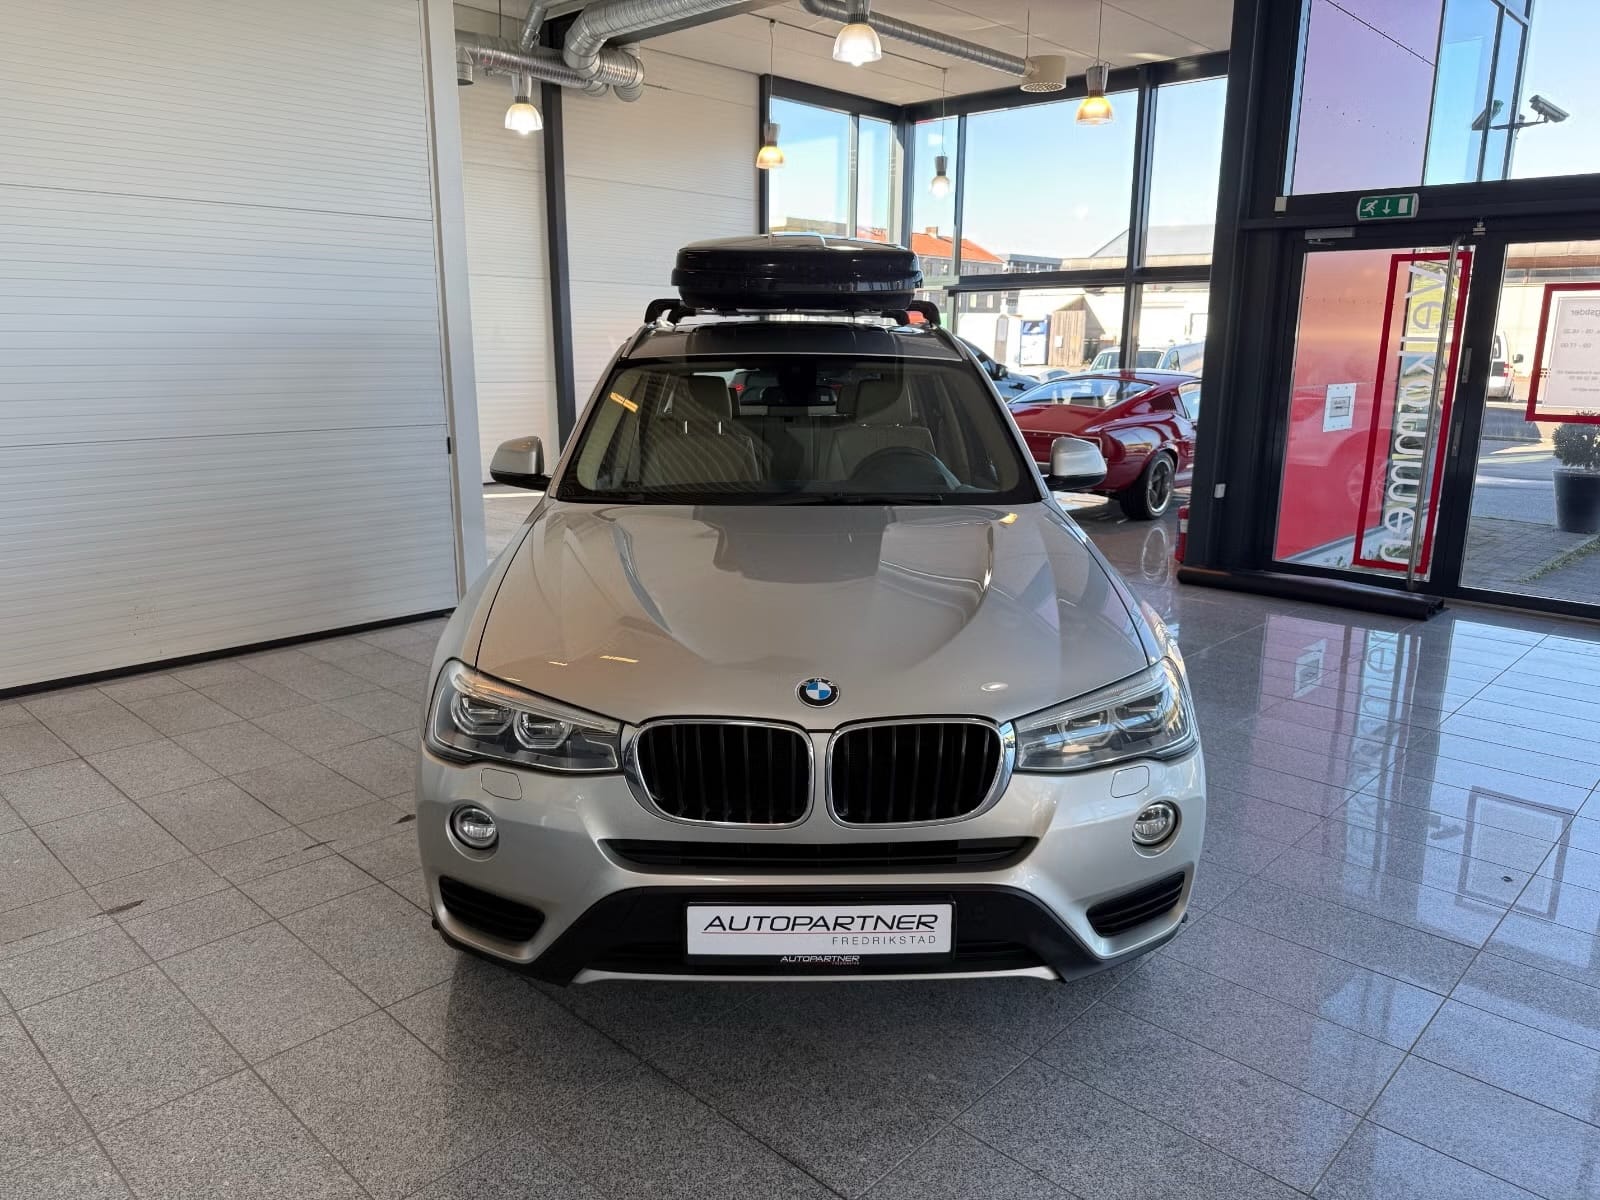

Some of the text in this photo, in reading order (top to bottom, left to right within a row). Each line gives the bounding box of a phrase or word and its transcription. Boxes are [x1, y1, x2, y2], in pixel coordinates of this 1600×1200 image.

[703, 914, 939, 932] AUTOPARTNER
[832, 935, 937, 946] FREDRIKSTAD
[780, 955, 861, 963] AUTOPARTNER
